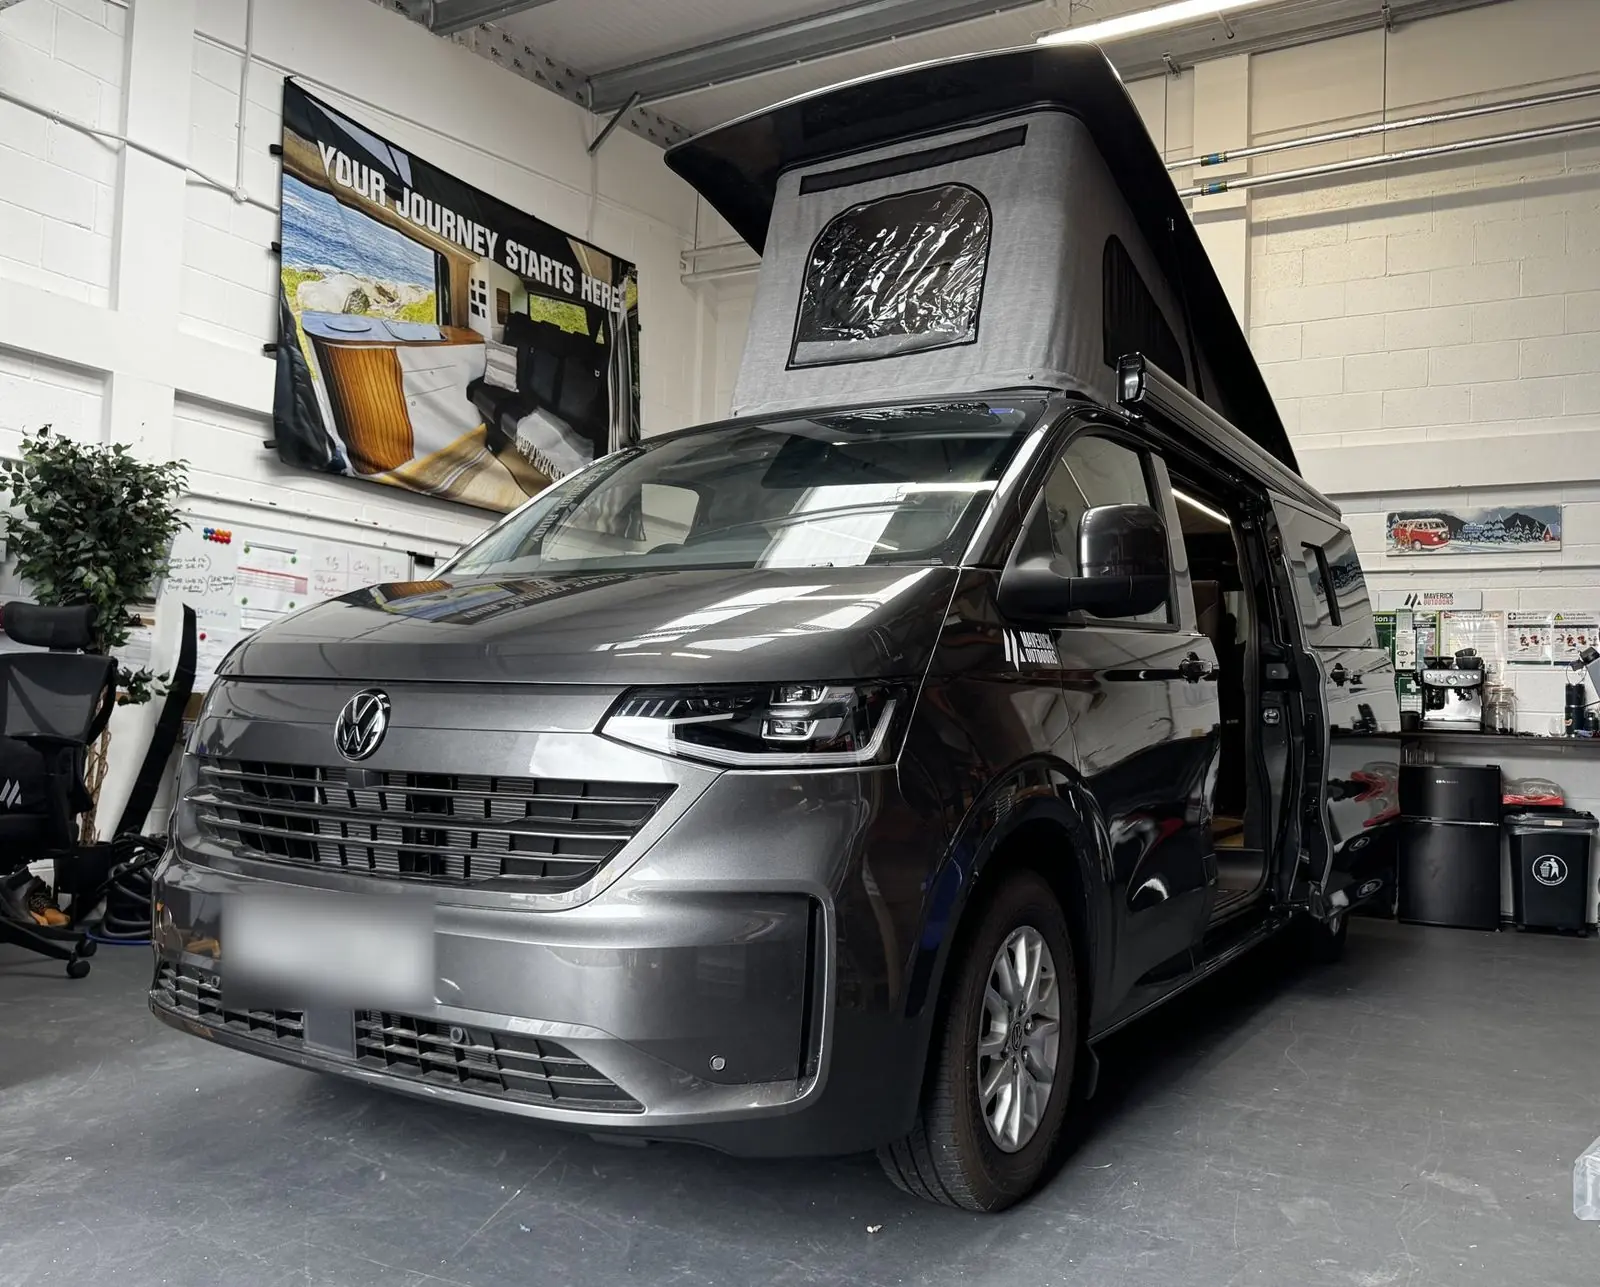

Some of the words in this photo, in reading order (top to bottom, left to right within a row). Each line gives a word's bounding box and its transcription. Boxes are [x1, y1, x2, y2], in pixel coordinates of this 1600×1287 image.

[317, 139, 386, 206] YOUR
[395, 186, 498, 260] JOURNEY
[505, 239, 574, 294] STARTS
[581, 272, 621, 312] HERE
[1423, 592, 1454, 600] MAVERICK
[1020, 631, 1054, 649] MAVERICK
[1025, 648, 1057, 664] OUTDOORS
